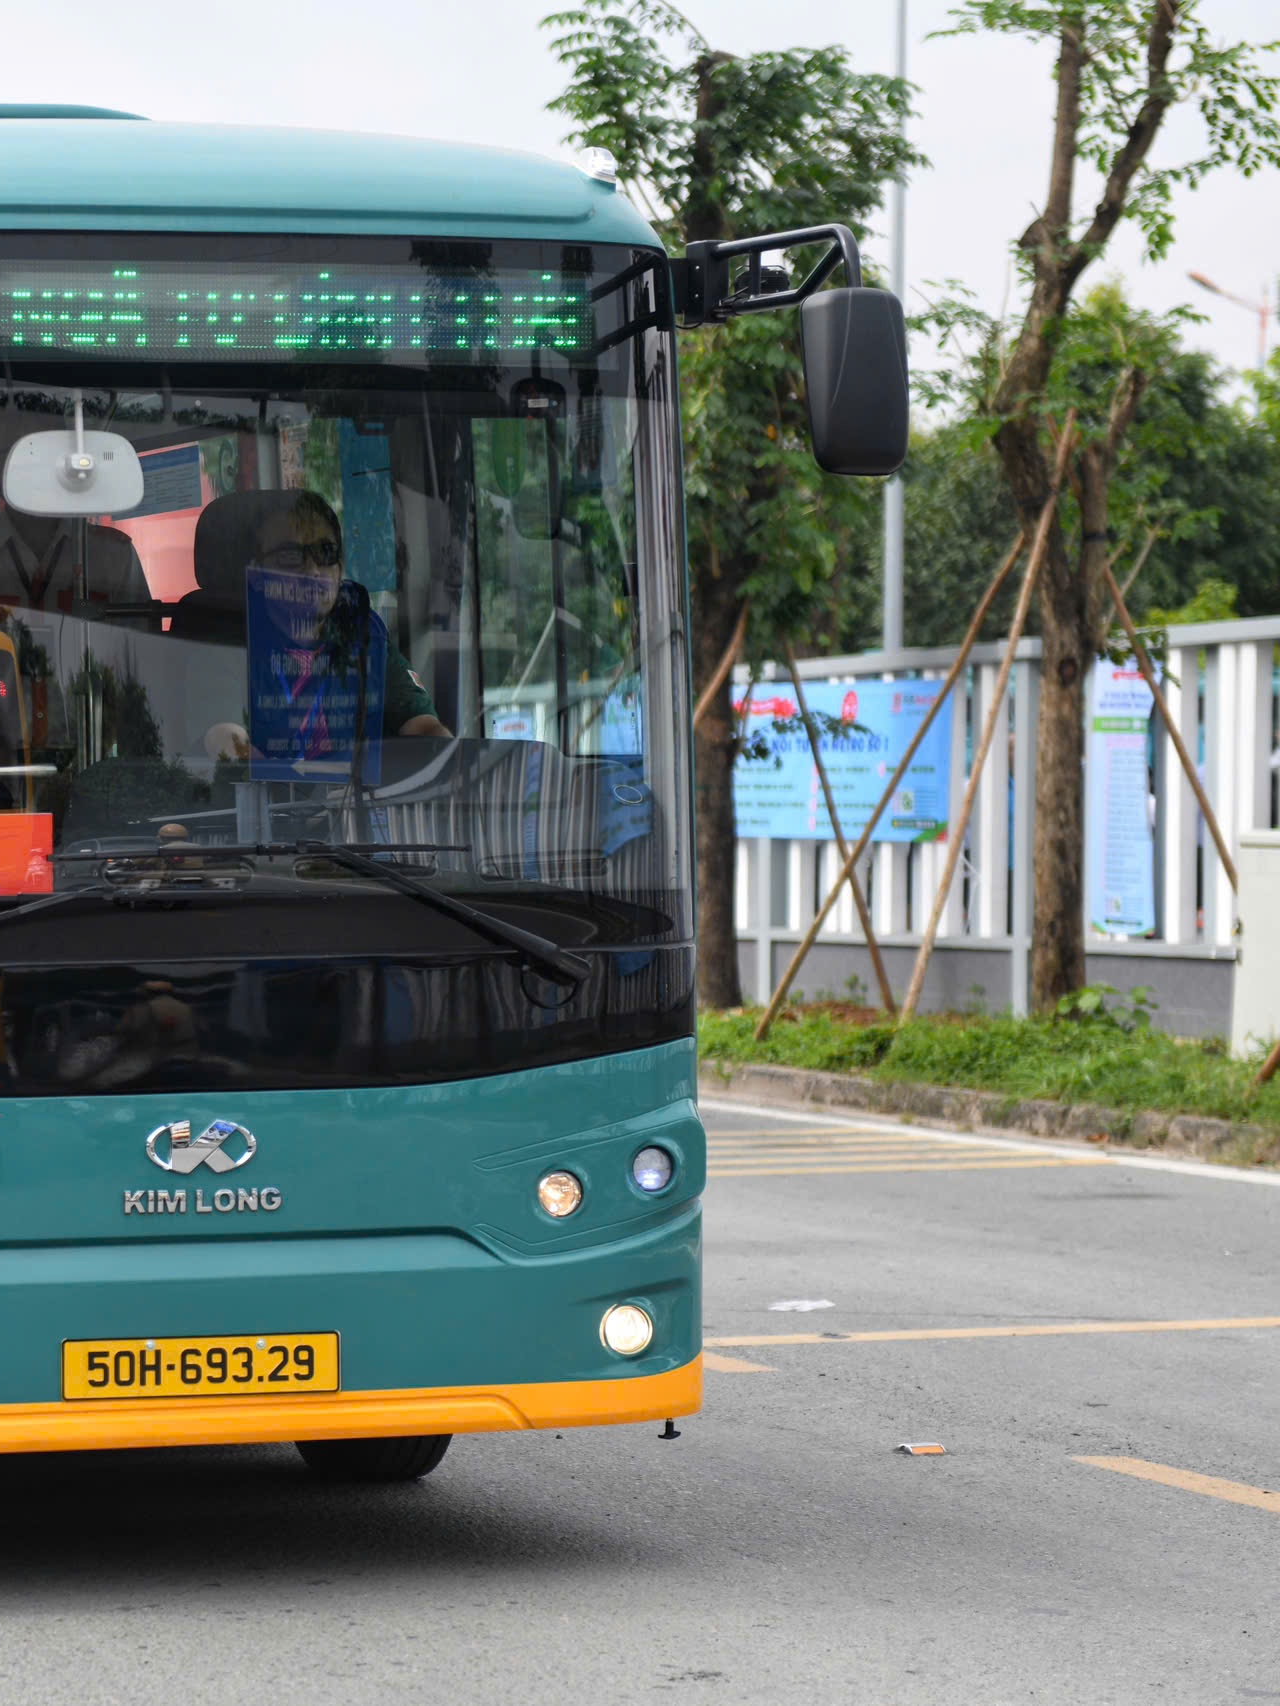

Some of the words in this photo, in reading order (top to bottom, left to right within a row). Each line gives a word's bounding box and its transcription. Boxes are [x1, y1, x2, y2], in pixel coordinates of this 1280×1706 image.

[123, 1188, 187, 1214] KIM
[195, 1186, 283, 1213] LONG
[87, 1345, 315, 1388] 50H-693.29
